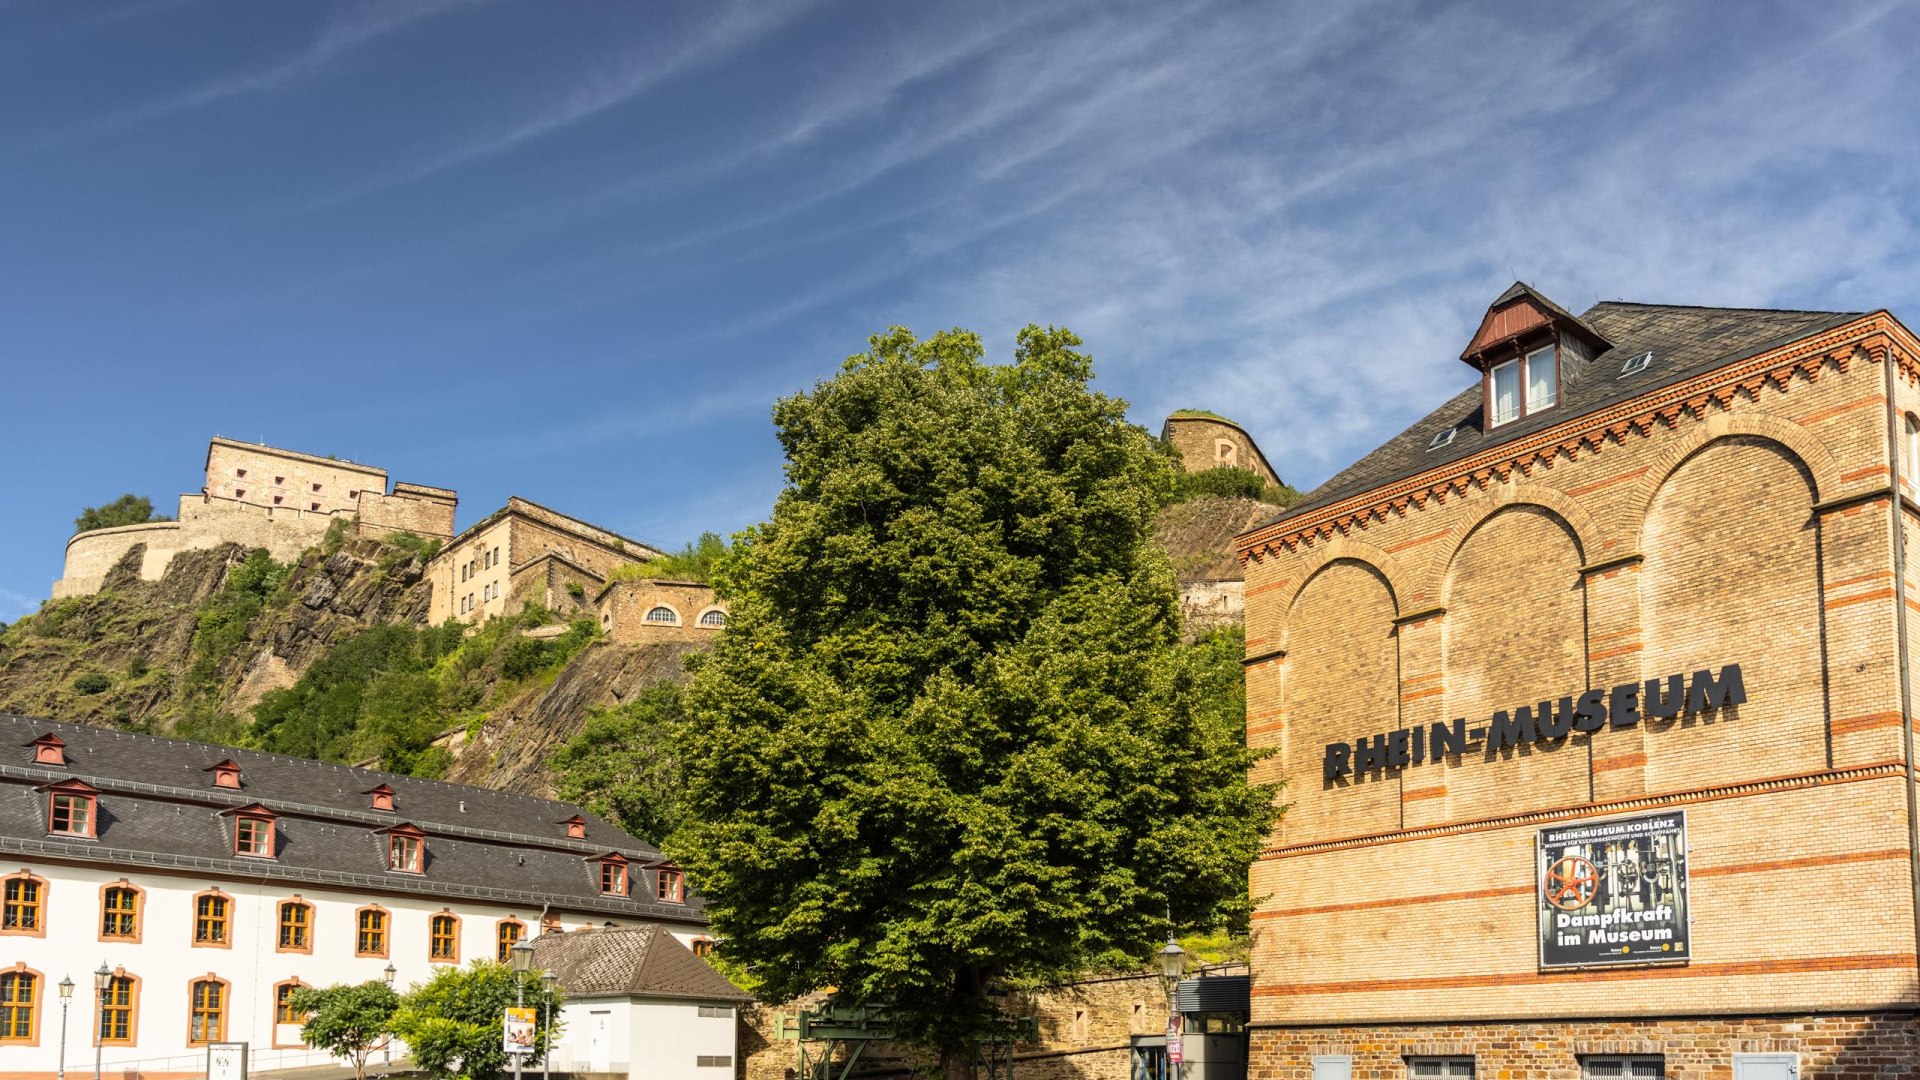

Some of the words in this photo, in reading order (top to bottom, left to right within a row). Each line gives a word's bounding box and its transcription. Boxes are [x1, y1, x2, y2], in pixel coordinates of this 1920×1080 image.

[1325, 663, 1748, 779] RHEIN-MUSEUM
[1548, 826, 1625, 841] RHEIN-MUSEUM
[1627, 819, 1675, 832] KOBLENZ
[1557, 905, 1672, 928] Dampfkraft
[1557, 931, 1581, 946] im
[1588, 928, 1673, 944] Museum
